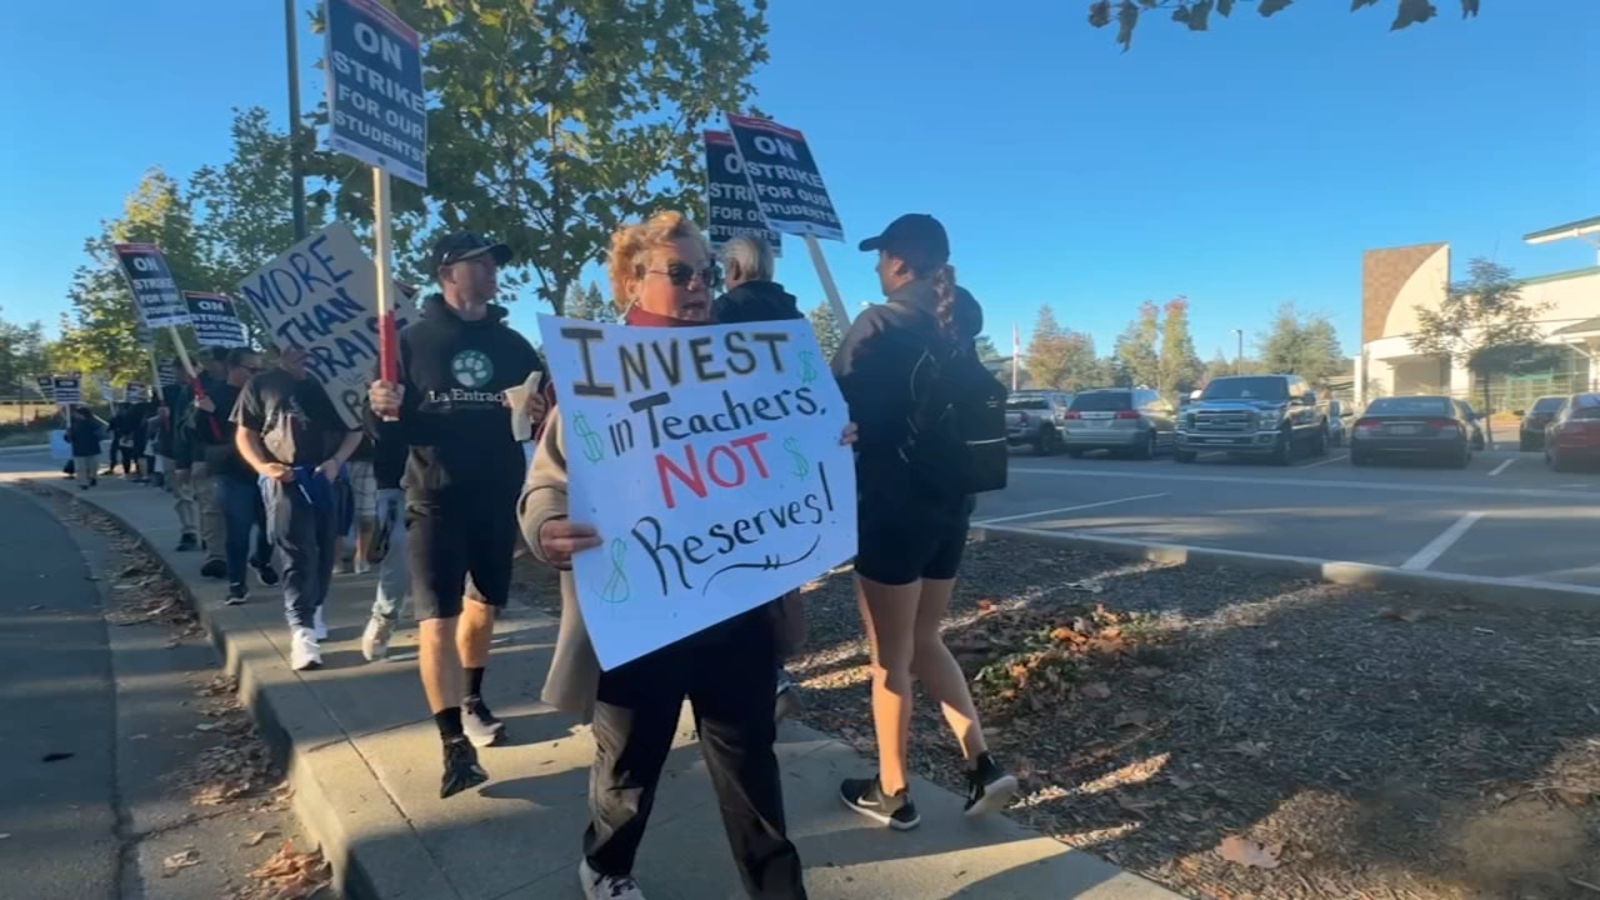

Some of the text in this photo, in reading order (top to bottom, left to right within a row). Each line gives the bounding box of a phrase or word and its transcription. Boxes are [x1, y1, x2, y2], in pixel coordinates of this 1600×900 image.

[354, 22, 402, 70] ON
[333, 51, 425, 114] STRIKE
[338, 84, 423, 140] FOR OUR
[724, 153, 744, 174] O
[754, 136, 798, 161] ON
[709, 182, 754, 201] STRI
[746, 161, 824, 188] STRIKE
[756, 184, 831, 208] FOR OUR
[712, 206, 742, 221] FOR
[133, 257, 159, 271] ON
[242, 234, 354, 329] MORE
[198, 301, 224, 311] ON
[277, 286, 366, 349] THAN
[302, 303, 408, 384] PRAI
[560, 326, 789, 398] INVEST
[428, 389, 449, 403] La
[607, 412, 634, 457] in
[654, 431, 771, 510] NOT
[630, 461, 837, 596] Reserves!
